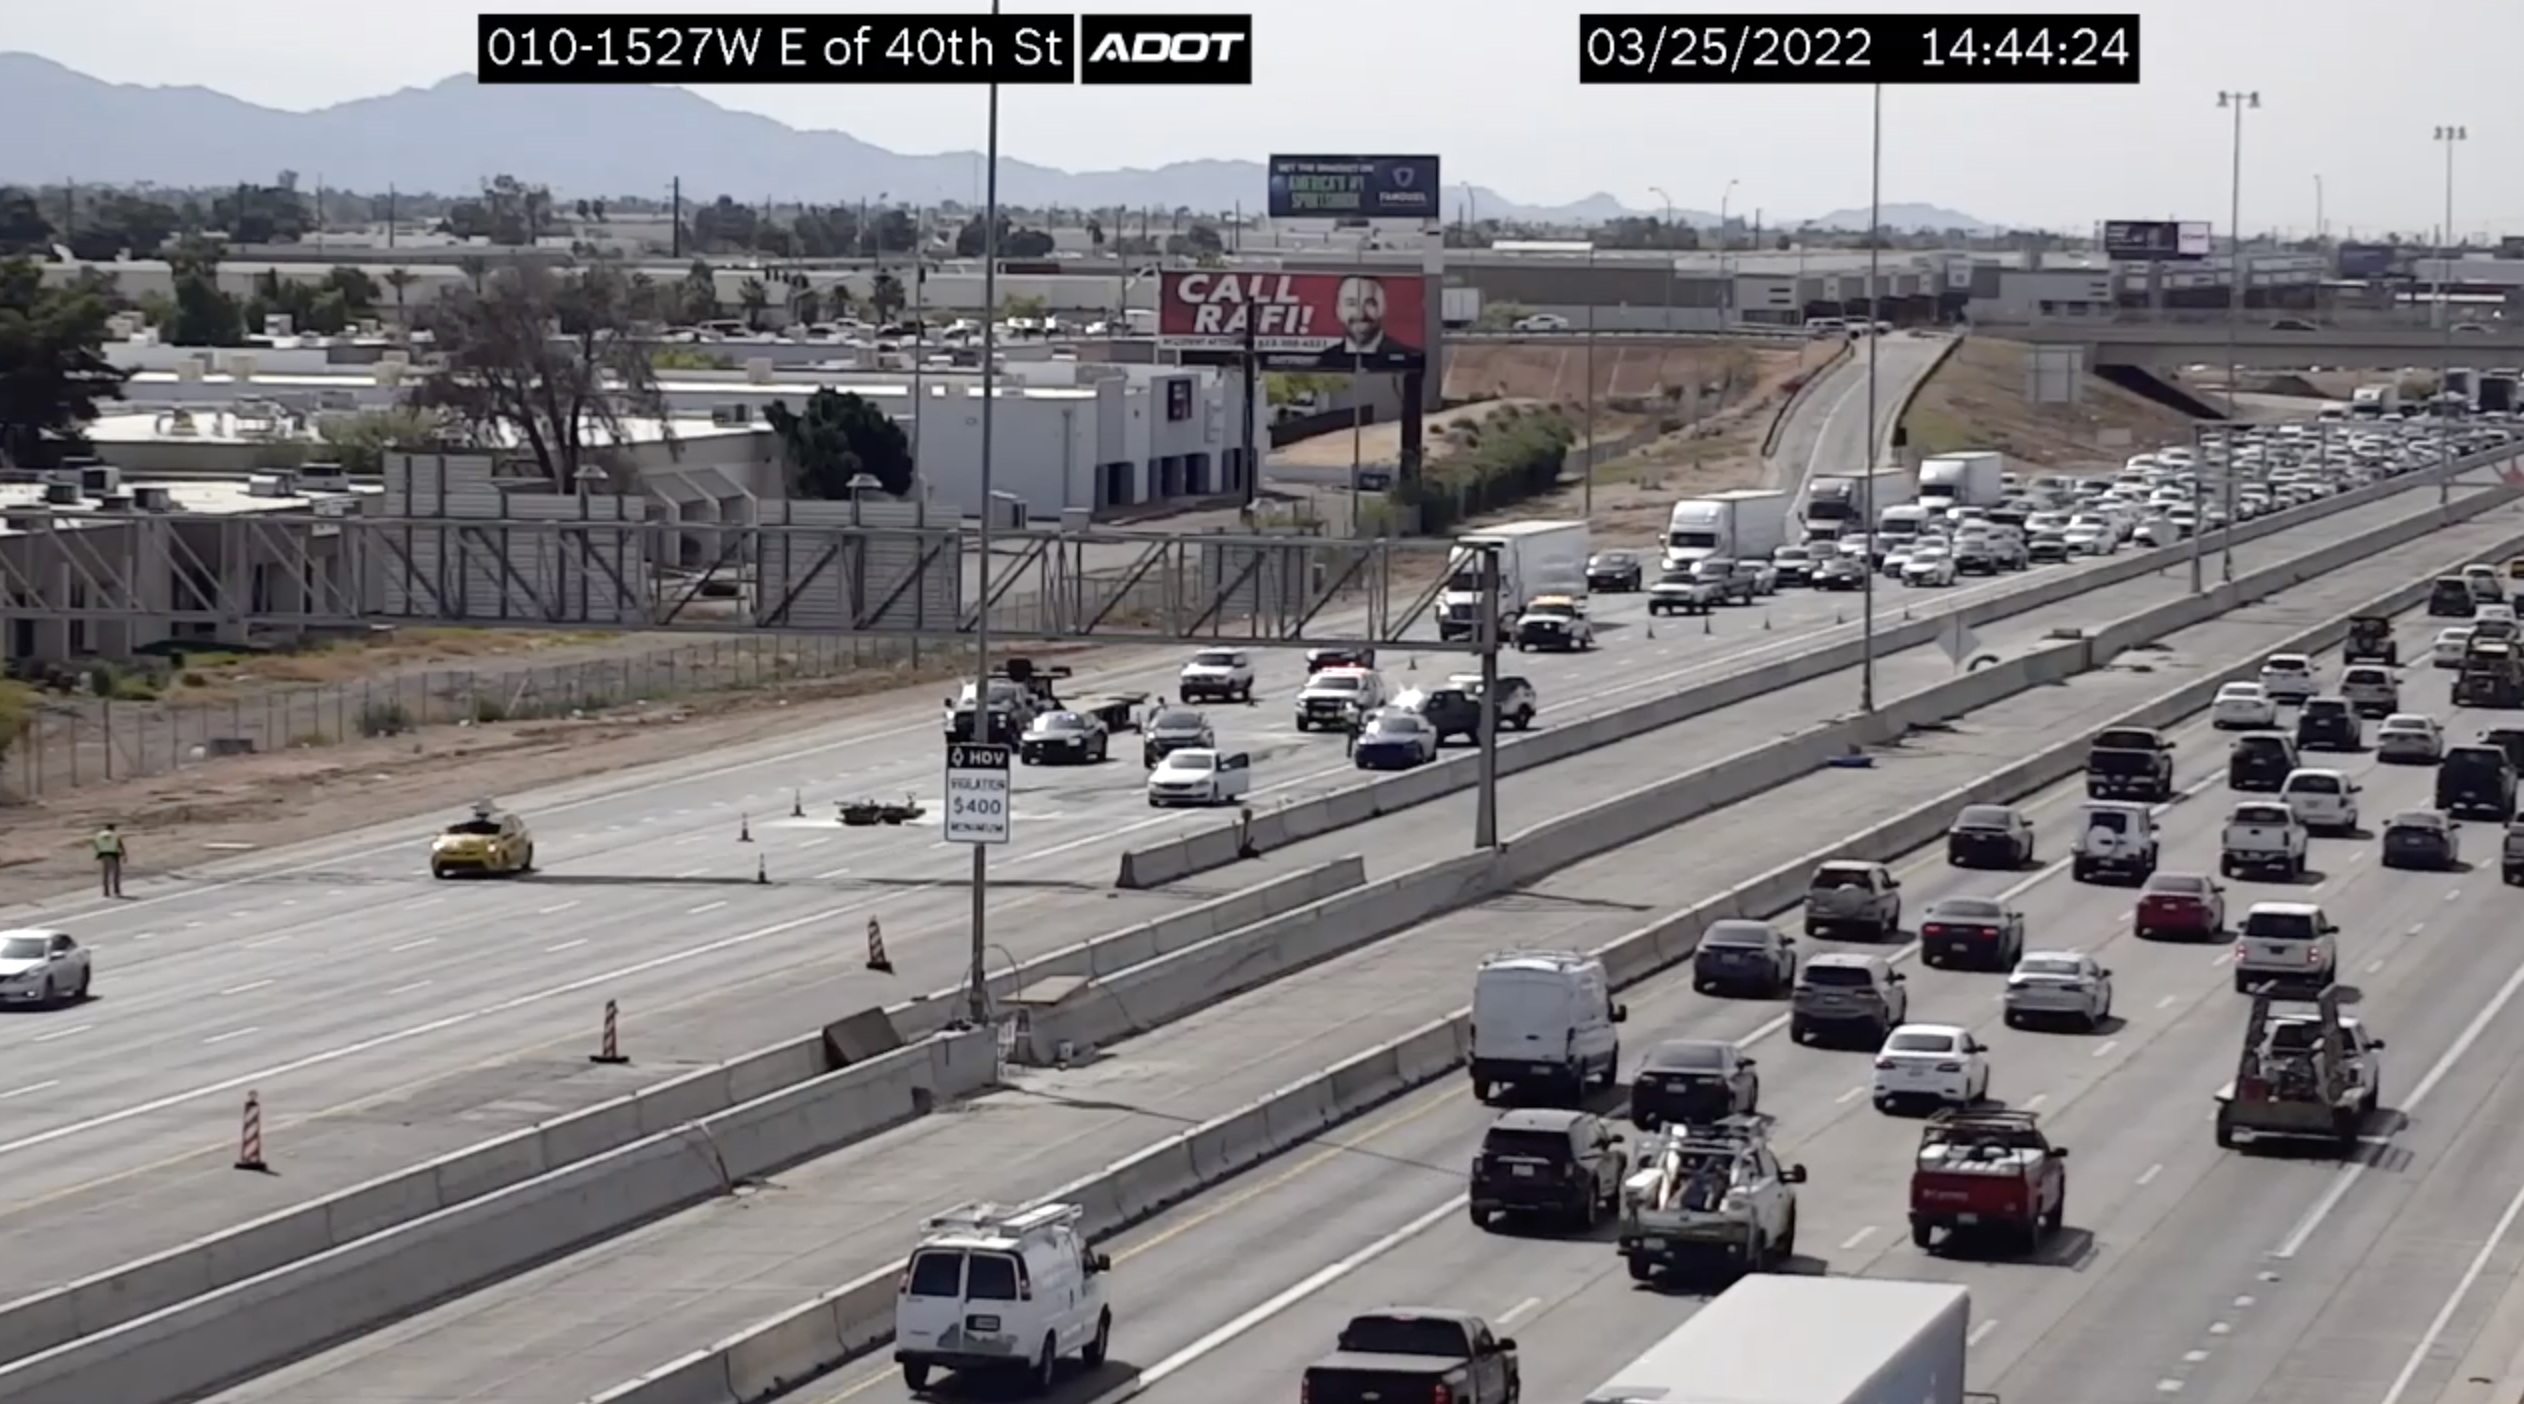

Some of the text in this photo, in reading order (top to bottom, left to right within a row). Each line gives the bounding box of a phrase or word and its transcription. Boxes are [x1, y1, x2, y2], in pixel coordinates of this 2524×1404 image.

[1177, 273, 1300, 304] CALL
[1193, 304, 1314, 335] RAFI!
[969, 750, 1005, 765] HOV
[953, 796, 1002, 815] $400
